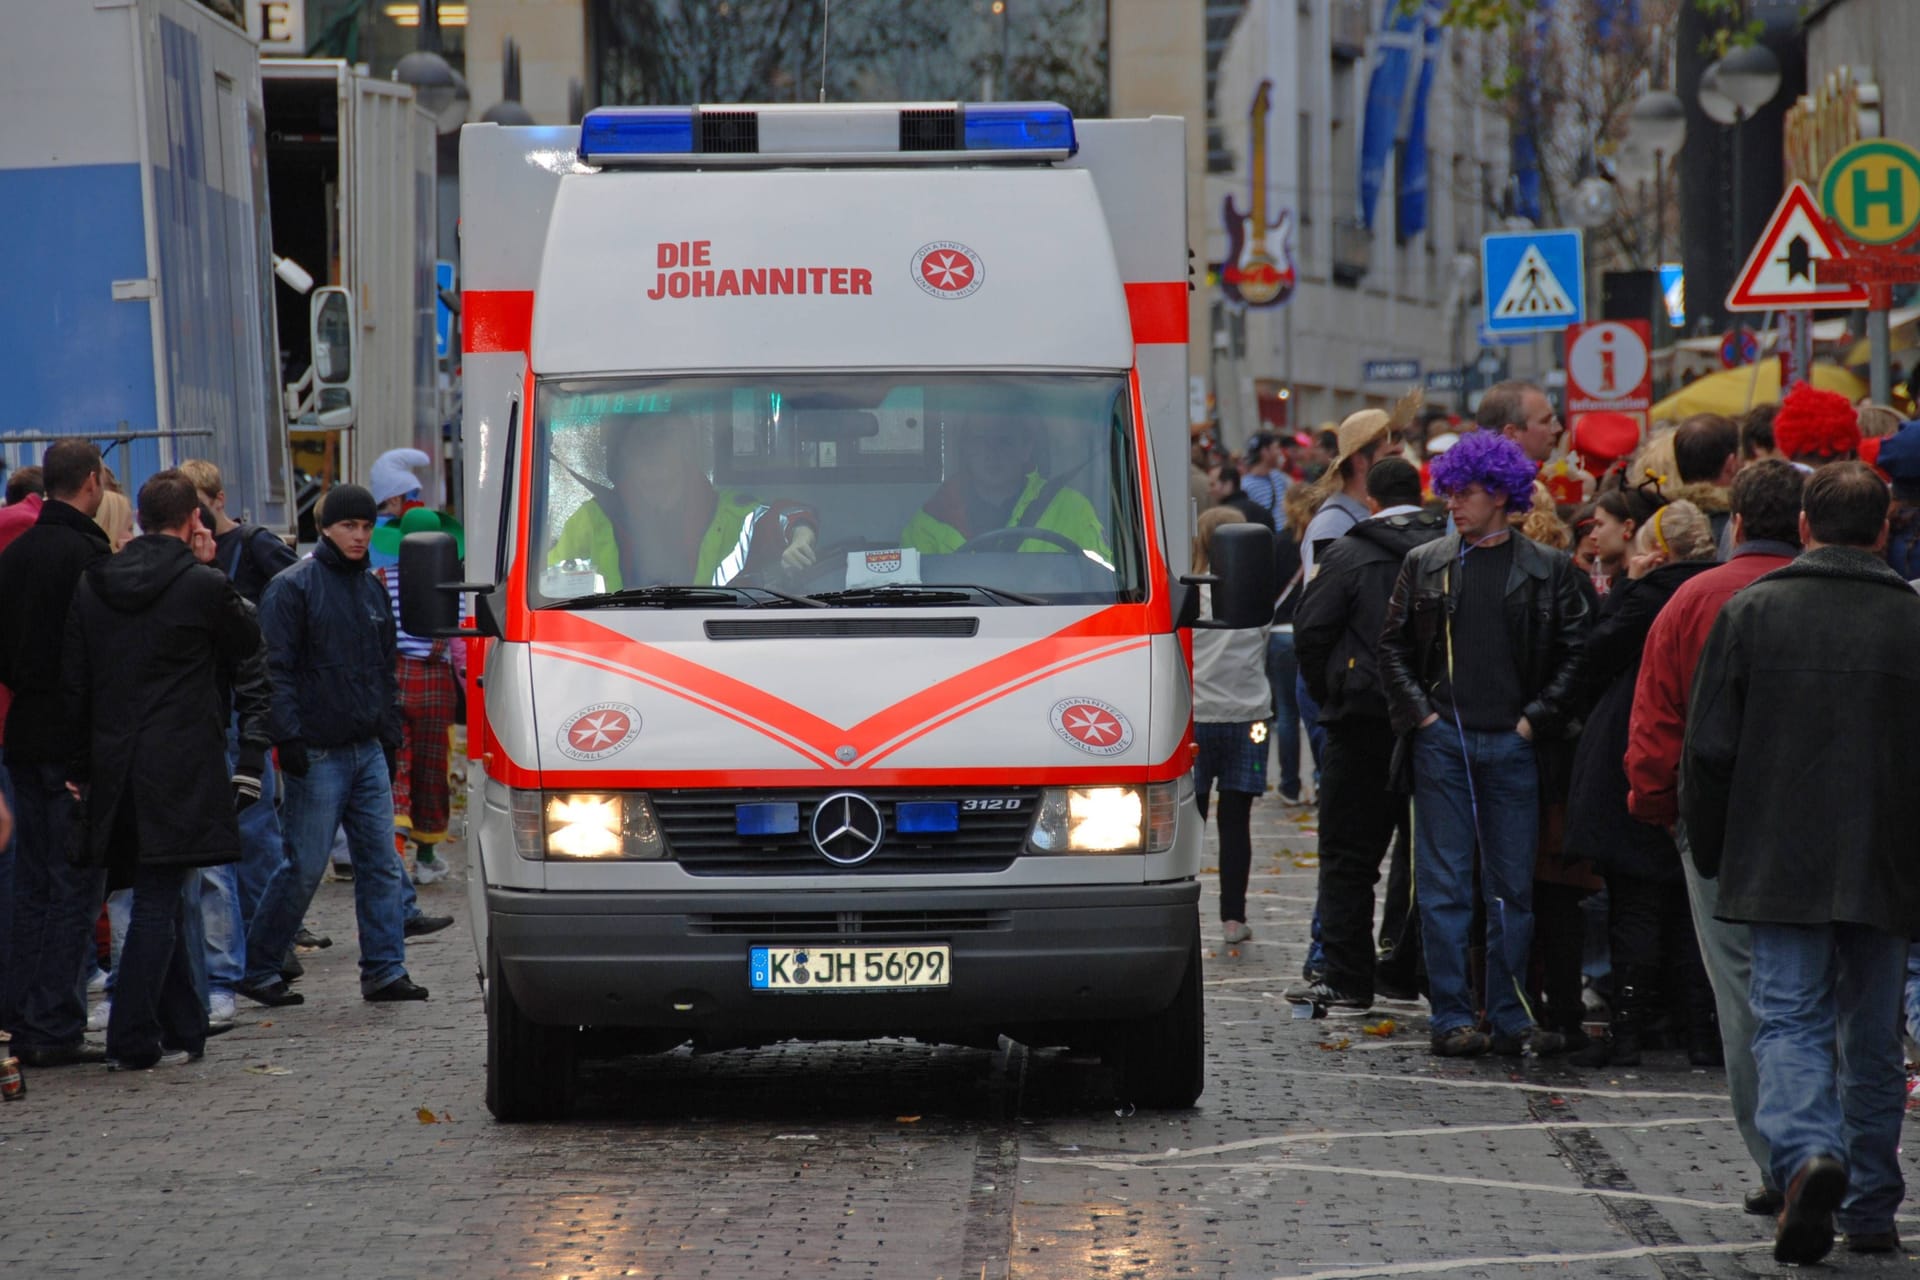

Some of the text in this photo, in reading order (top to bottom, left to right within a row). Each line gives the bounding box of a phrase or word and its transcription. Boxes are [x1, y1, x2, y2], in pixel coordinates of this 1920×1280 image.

[260, 2, 292, 42] E
[1853, 167, 1904, 227] H
[657, 240, 711, 268] DIE
[647, 267, 873, 300] JOHANNITER
[962, 799, 1021, 810] 312 D
[755, 971, 764, 981] D
[770, 951, 945, 983] K JH 5699
